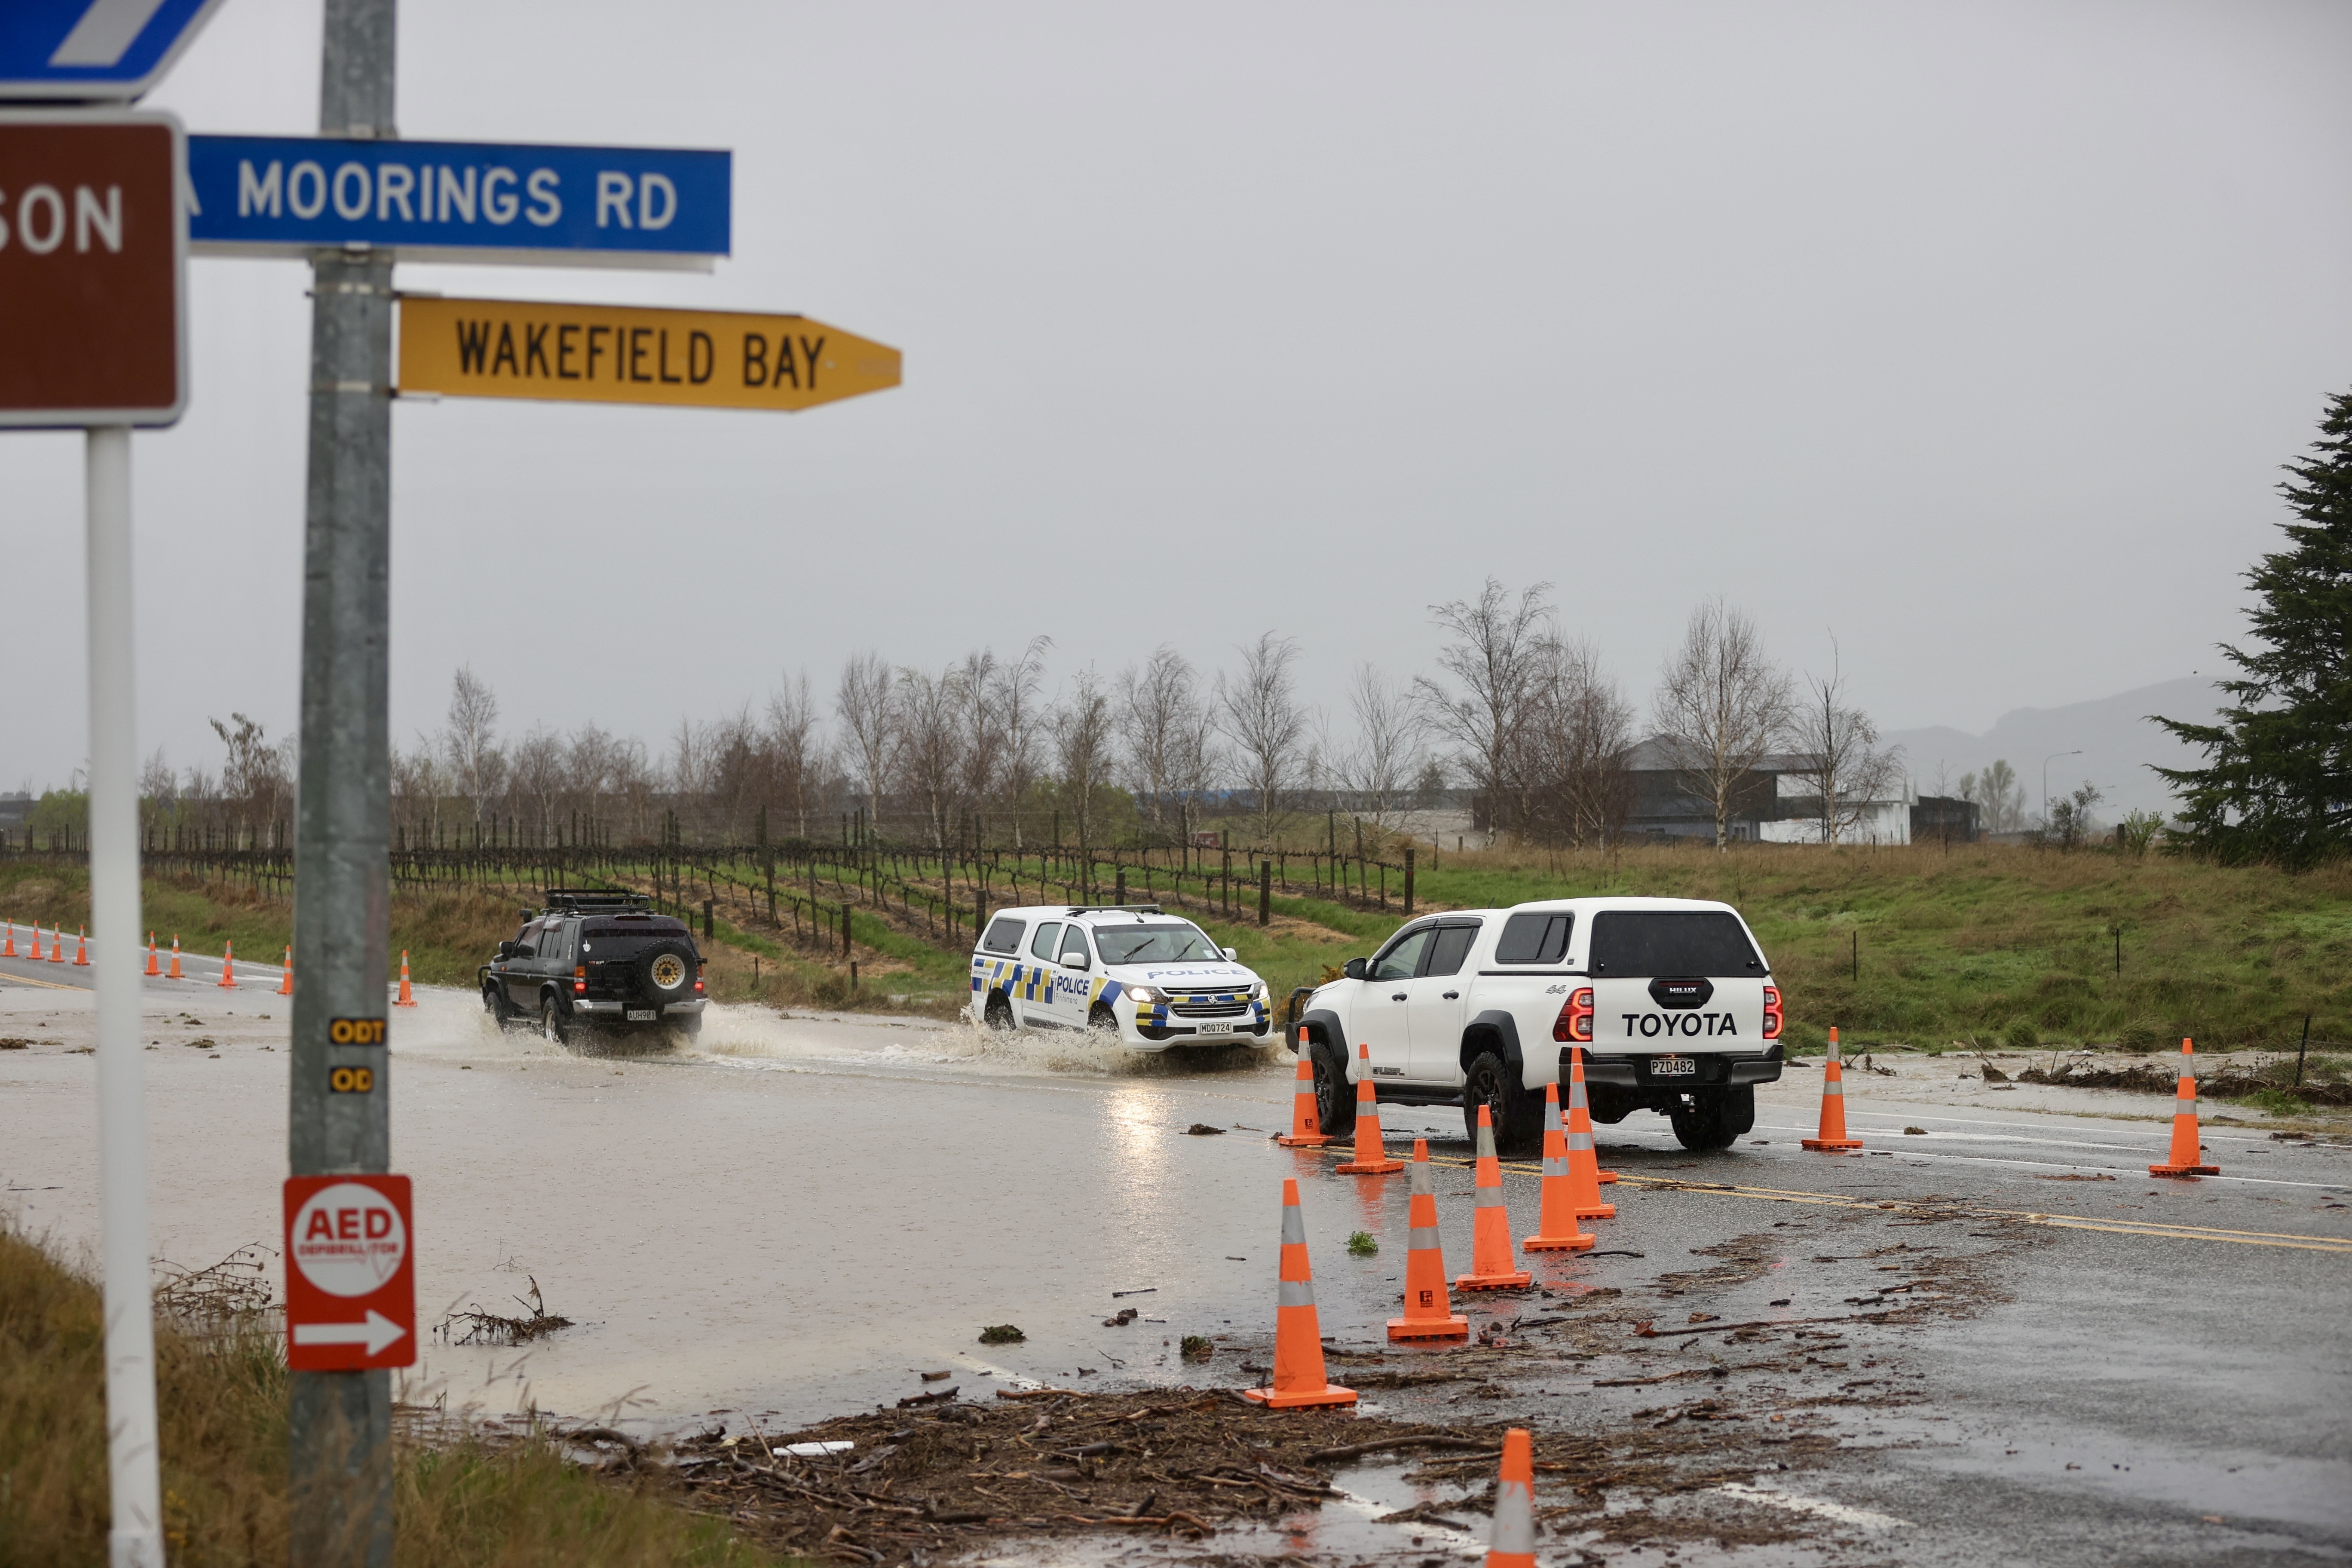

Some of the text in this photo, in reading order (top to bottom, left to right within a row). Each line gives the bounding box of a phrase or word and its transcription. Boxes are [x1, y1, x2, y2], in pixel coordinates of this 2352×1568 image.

[237, 158, 562, 227] MOORINGS
[596, 171, 677, 230] RD
[0, 183, 124, 255] ON
[456, 318, 826, 390] WAKEFIELD BAY
[1057, 975, 1090, 996] POLICE
[1147, 969, 1247, 979] POLICE
[1056, 992, 1078, 1004] Pirihimana
[629, 1011, 655, 1020] AUH901
[1201, 1023, 1230, 1032] MDQ724
[1622, 1013, 1737, 1037] TOYOTA
[331, 1019, 386, 1044] ODT
[1652, 1061, 1694, 1073] PZD482
[331, 1067, 374, 1093] OD
[306, 1208, 393, 1240] AED
